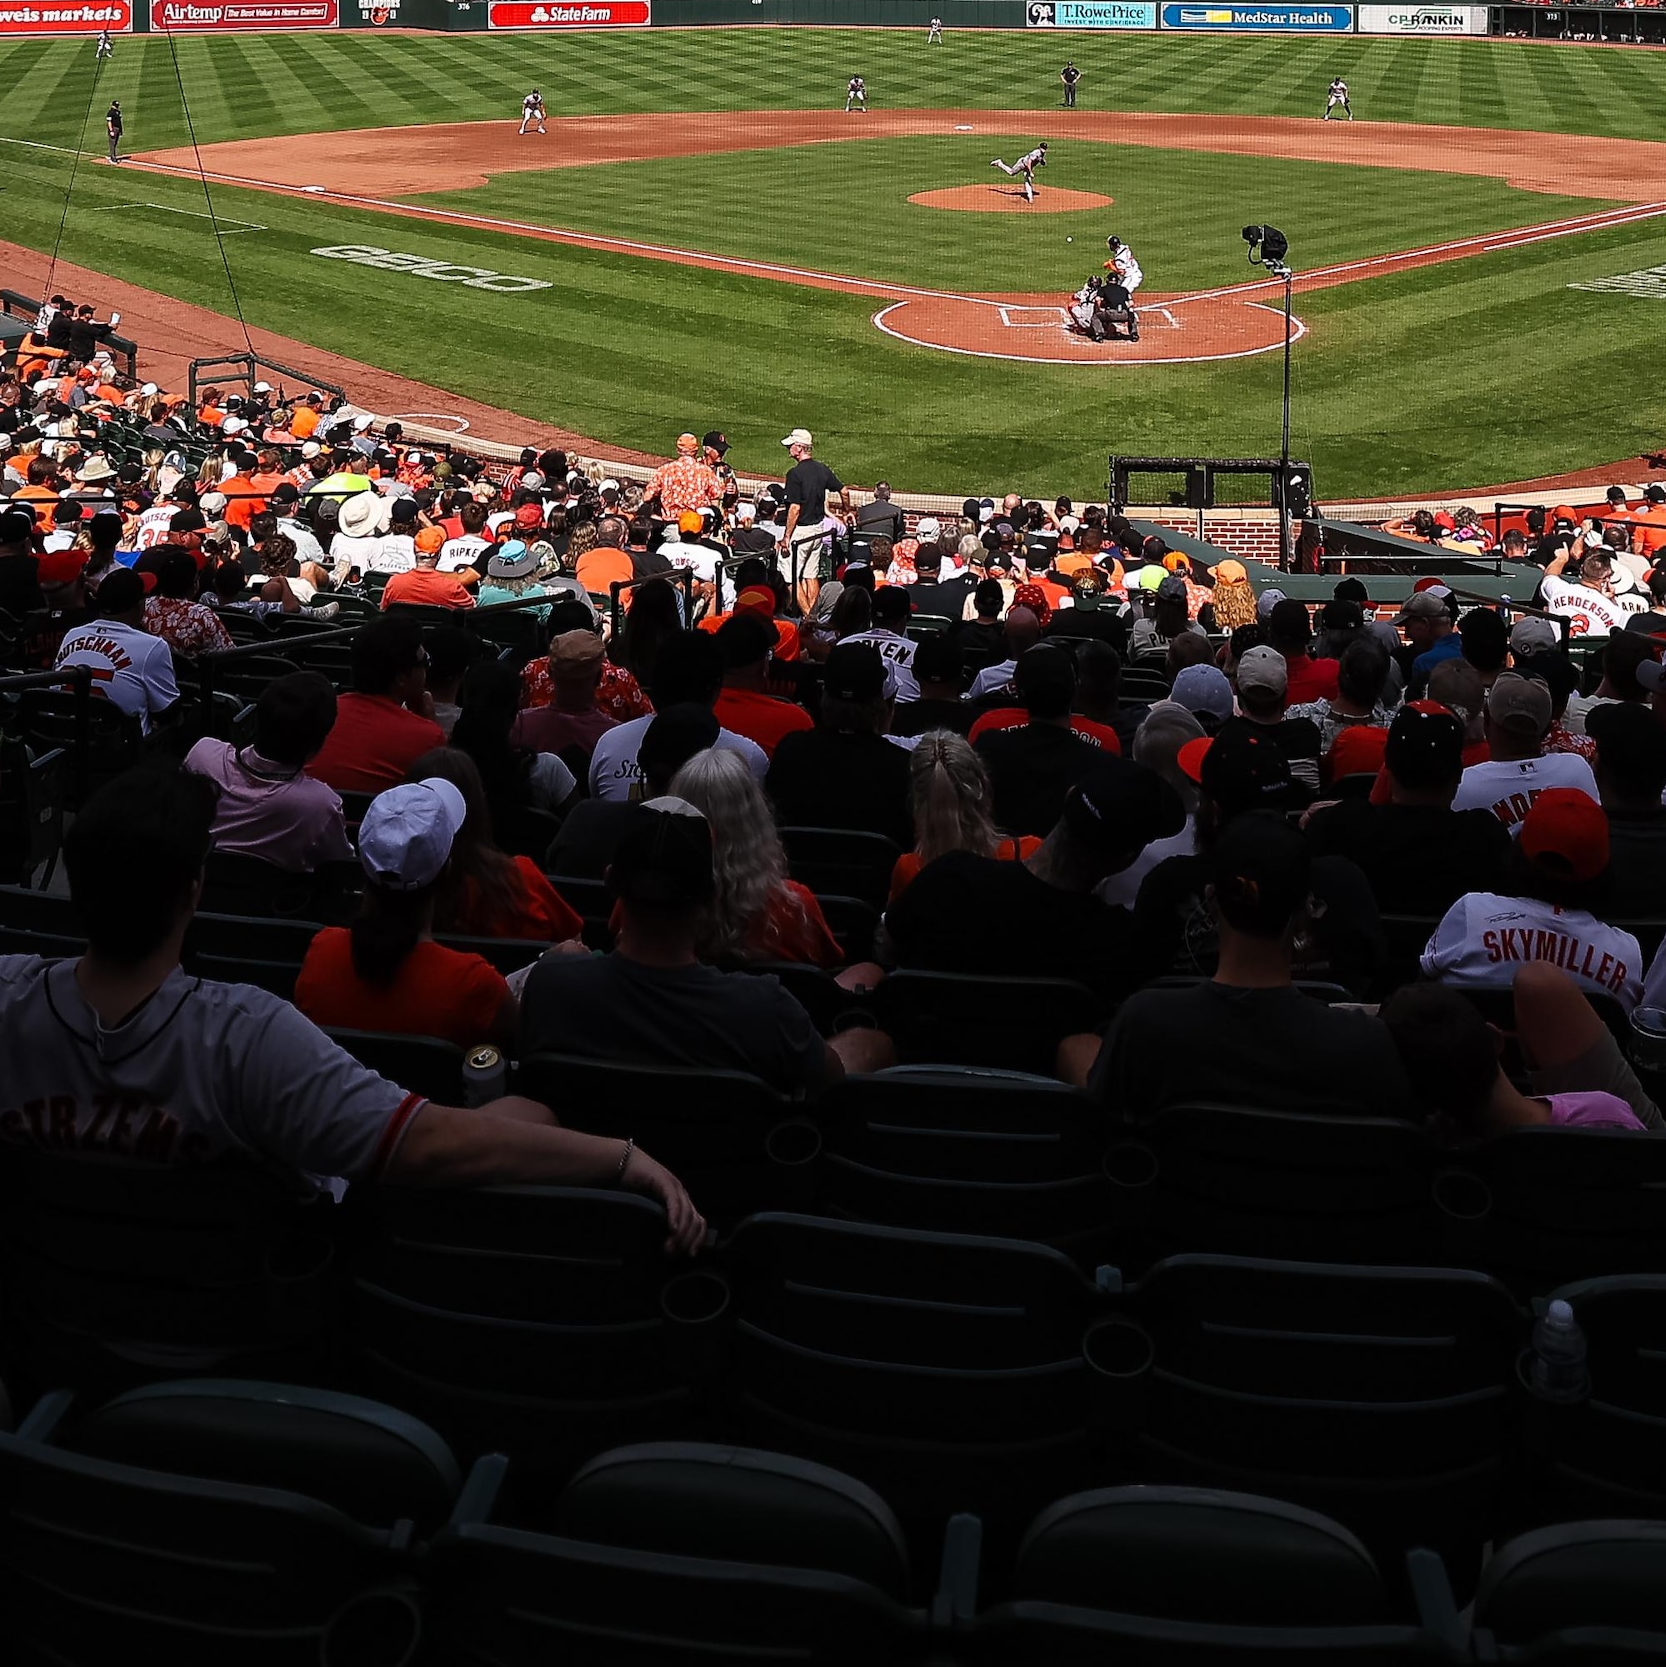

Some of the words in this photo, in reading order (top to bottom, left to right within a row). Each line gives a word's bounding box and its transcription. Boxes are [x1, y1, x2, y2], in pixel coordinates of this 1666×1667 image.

[42, 5, 123, 22] markets
[163, 2, 222, 23] Airtemp
[457, 2, 470, 11] 376
[1234, 11, 1286, 23] MedStar
[1289, 12, 1333, 24] Health
[310, 245, 554, 291] GEICO
[1554, 595, 1614, 628] HENDERSON
[1483, 930, 1628, 995] SKYMILLER
